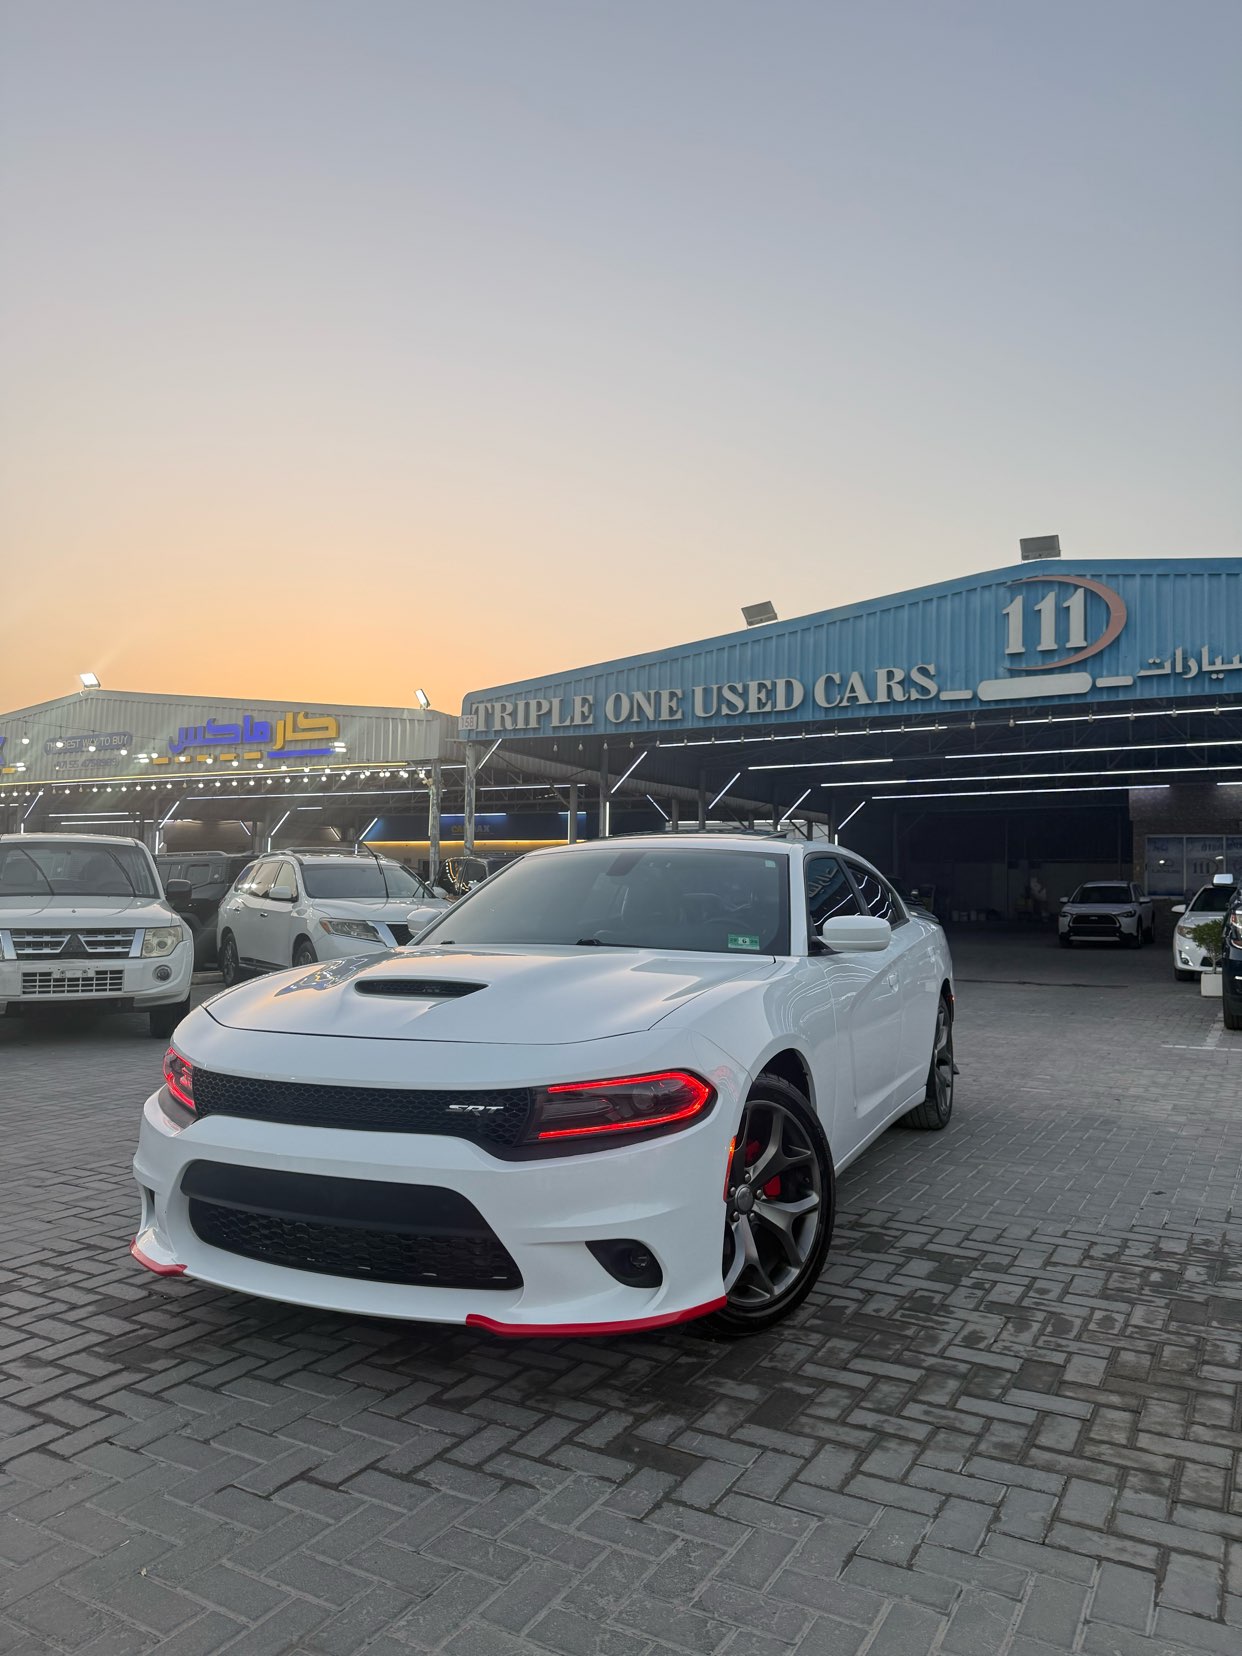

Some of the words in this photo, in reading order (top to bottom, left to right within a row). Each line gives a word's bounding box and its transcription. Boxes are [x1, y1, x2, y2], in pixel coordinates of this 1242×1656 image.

[1002, 587, 1087, 654] 111
[471, 695, 593, 731] TRIPLE
[605, 688, 683, 723] ONE
[692, 678, 804, 718] USED
[814, 664, 938, 708] CARS
[46, 741, 62, 751] TH
[101, 737, 110, 746] TO
[112, 735, 127, 745] BUY
[168, 715, 271, 754] ماكس
[272, 712, 337, 750] كار
[445, 1104, 504, 1116] SRT
